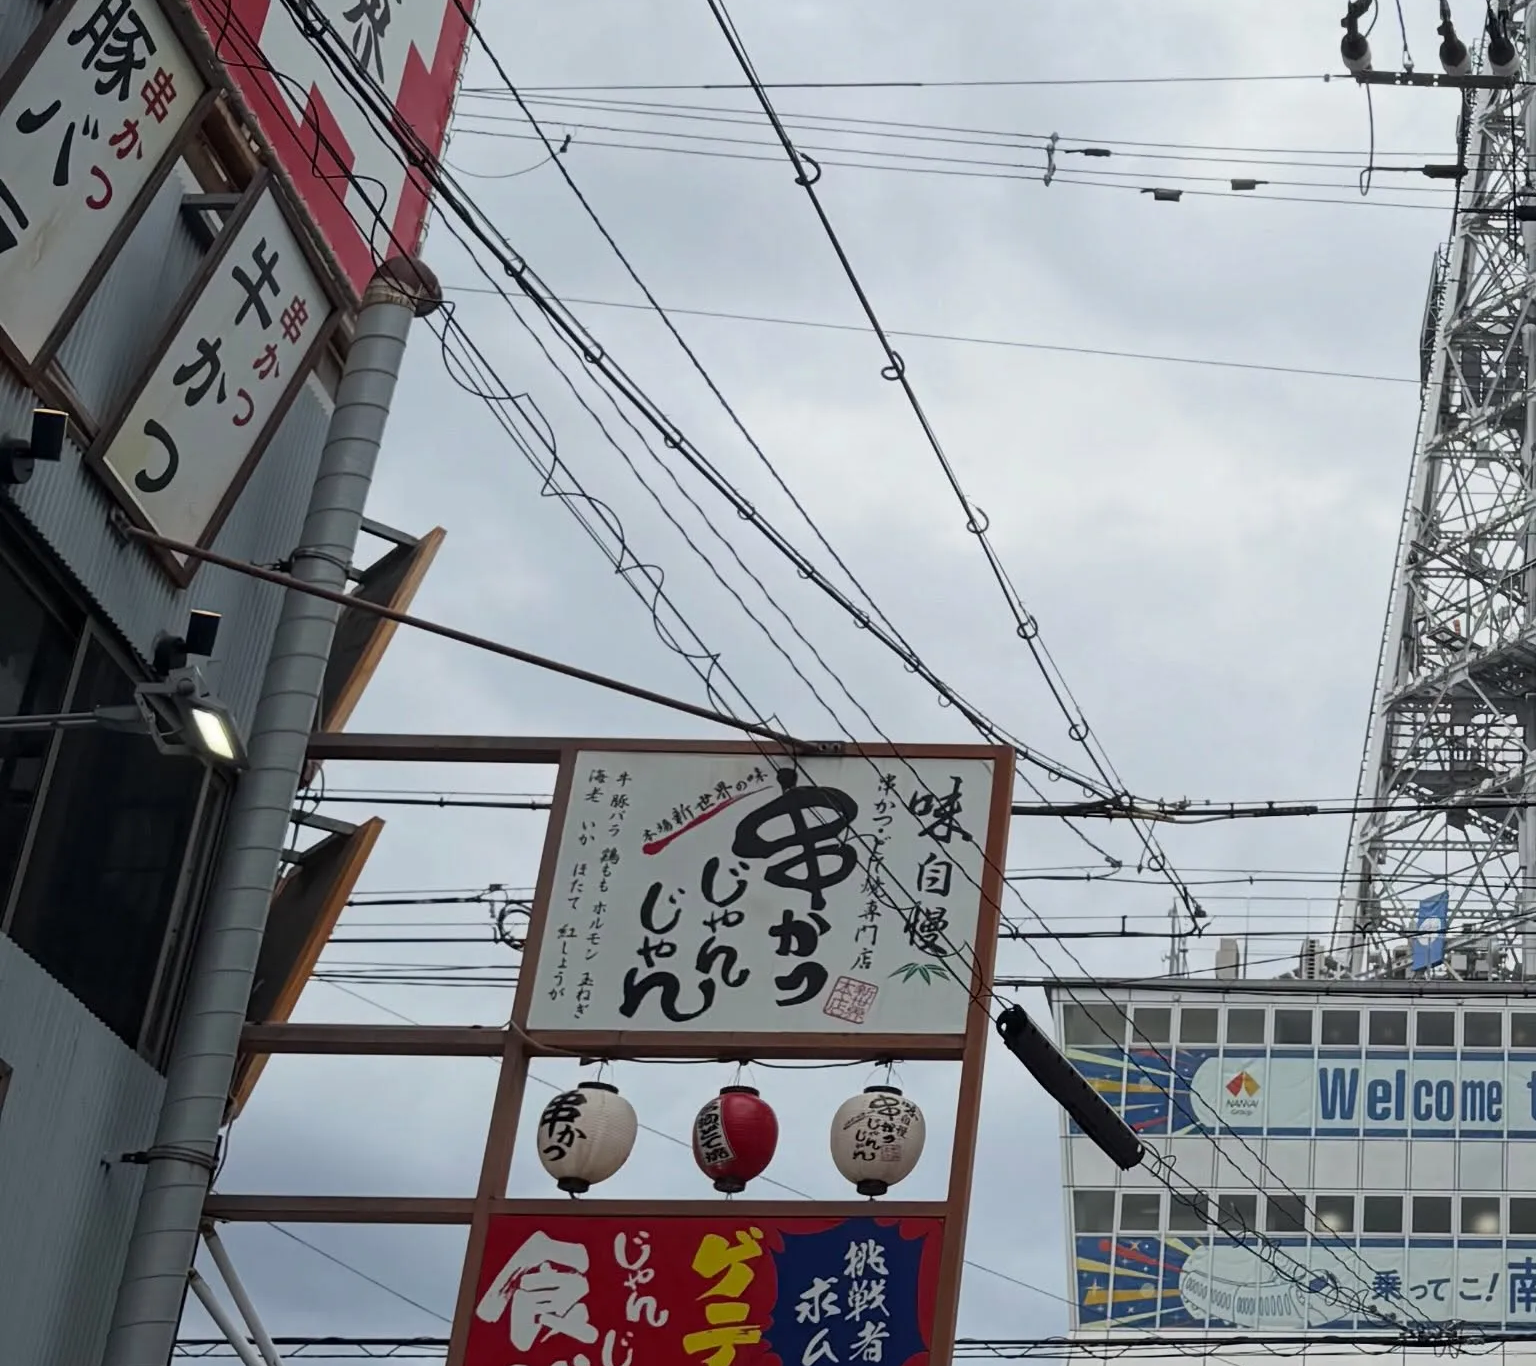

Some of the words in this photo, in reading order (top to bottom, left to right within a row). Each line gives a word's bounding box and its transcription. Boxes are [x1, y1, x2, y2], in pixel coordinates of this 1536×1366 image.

[84, 66, 178, 212] 串かつ
[134, 236, 281, 495] 牛かつ
[231, 294, 312, 429] 串かつ
[584, 768, 609, 804] 海老
[608, 793, 630, 837] 豚バラ
[616, 770, 633, 787] 牛
[578, 820, 596, 846] いか
[599, 846, 621, 893] 鶏もも
[903, 775, 973, 956] 味自慢
[566, 862, 588, 910] ほたて
[695, 856, 751, 988] じゃん
[731, 767, 858, 1007] 串かつ
[547, 922, 578, 1002] 紅しょうが
[585, 900, 608, 961] ホルモン
[618, 881, 717, 1023] じゃん
[573, 971, 594, 1020] 玉ねぎ
[540, 1089, 588, 1162] 串かつ
[1319, 1066, 1503, 1122] Welcome
[844, 1238, 890, 1364] 挑戦者
